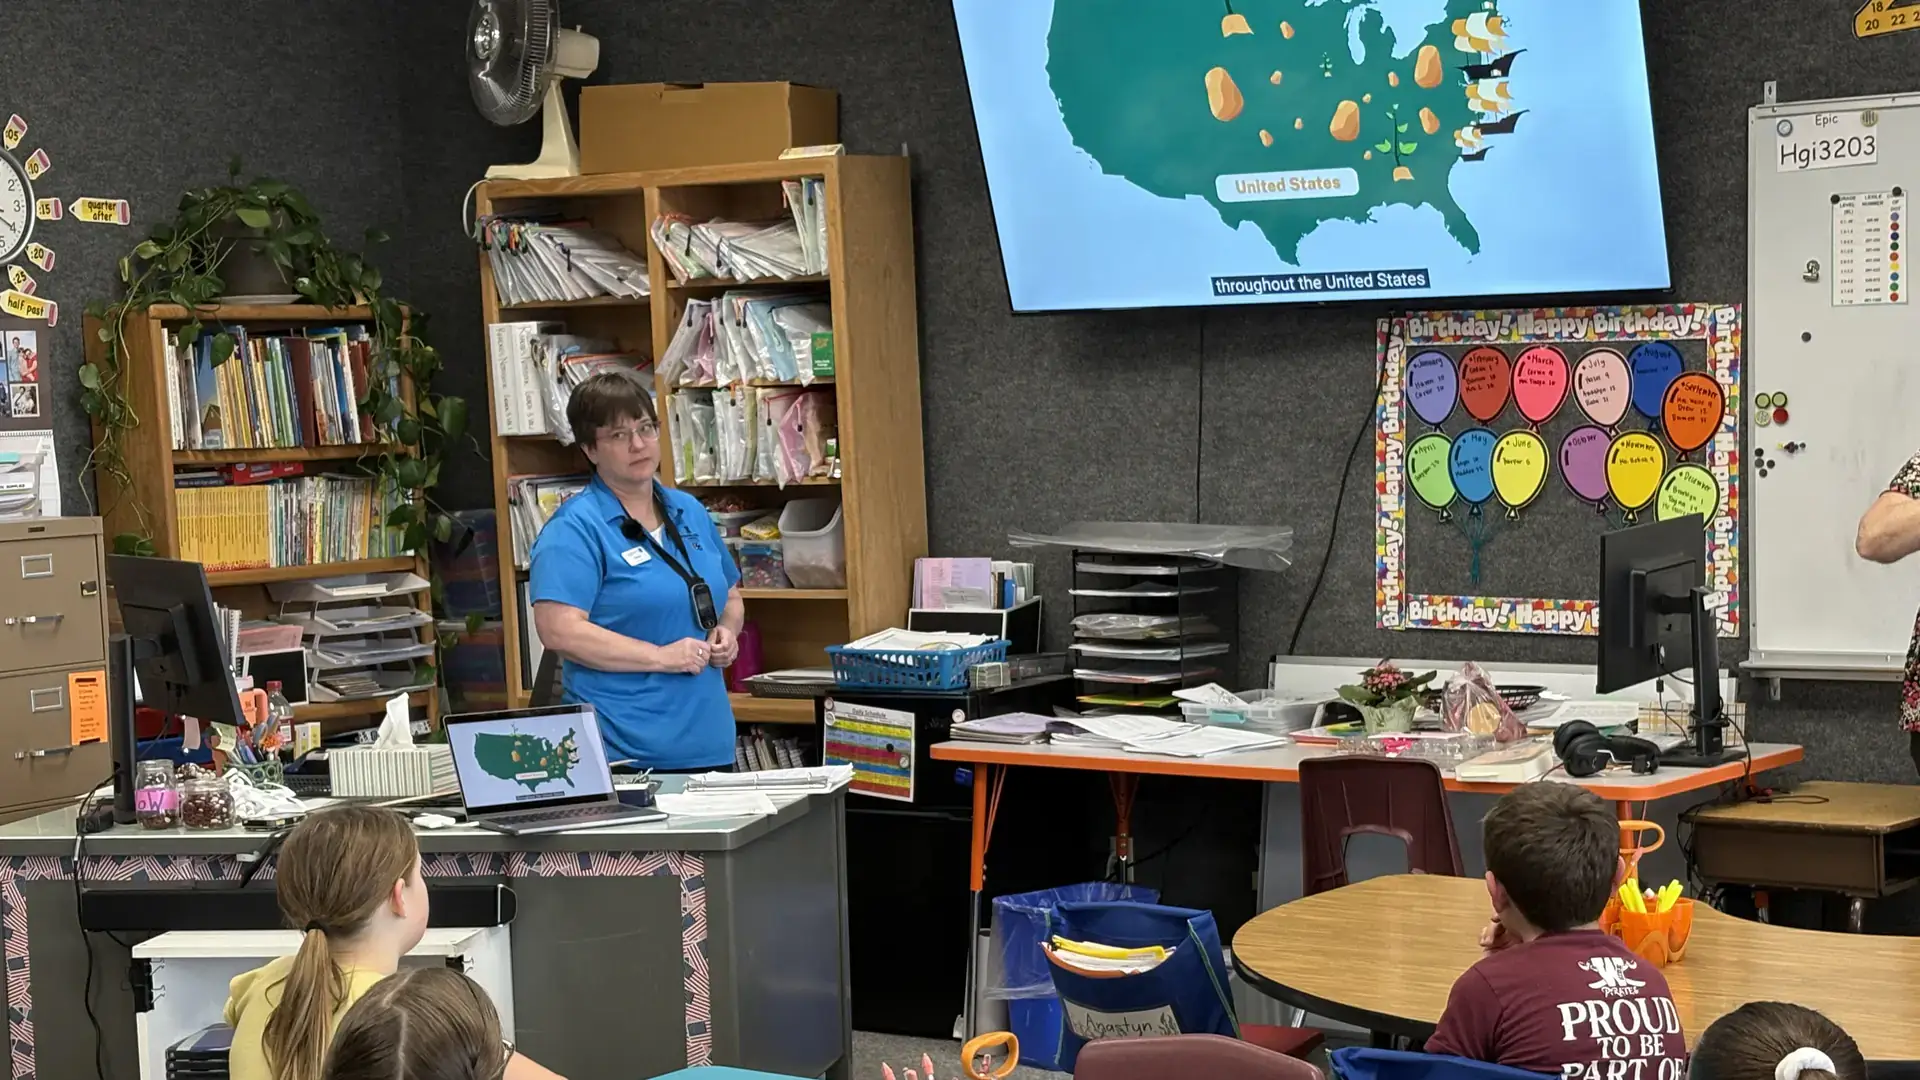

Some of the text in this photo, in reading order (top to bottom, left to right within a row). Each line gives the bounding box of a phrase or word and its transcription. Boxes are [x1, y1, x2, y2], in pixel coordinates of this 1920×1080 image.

[1872, 2, 1884, 13] 18
[1865, 11, 1920, 31] 20 22 2
[1815, 113, 1838, 128] Epic
[1780, 135, 1876, 169] Hgi3203
[8, 179, 15, 191] 2
[1235, 175, 1341, 194] United States
[13, 200, 21, 212] 3
[38, 203, 51, 215] :15
[87, 201, 116, 211] quarter
[92, 211, 113, 221] after
[30, 249, 44, 260] :20
[13, 271, 27, 284] :25
[1215, 271, 1426, 295] throughout the United States
[7, 295, 44, 317] half past
[1408, 307, 1703, 340] Birthday! Happy Birthday!
[1644, 347, 1672, 359] August
[1417, 357, 1444, 368] January
[1532, 354, 1554, 366] March
[1588, 359, 1606, 369] July
[1685, 381, 1718, 399] September
[1471, 434, 1488, 445] May
[1512, 436, 1532, 448] June
[1572, 433, 1597, 446] October
[1418, 443, 1436, 454] April
[1380, 438, 1403, 511] Happy
[1684, 471, 1712, 492] December
[1381, 517, 1403, 627] Birthday!
[1409, 601, 1511, 628] Birthday!
[1516, 603, 1587, 632] Happy
[1601, 985, 1639, 998] PIRATES
[1556, 996, 1680, 1041] PROUD
[1597, 1034, 1666, 1059] TO BE
[1561, 1058, 1648, 1080] PART
